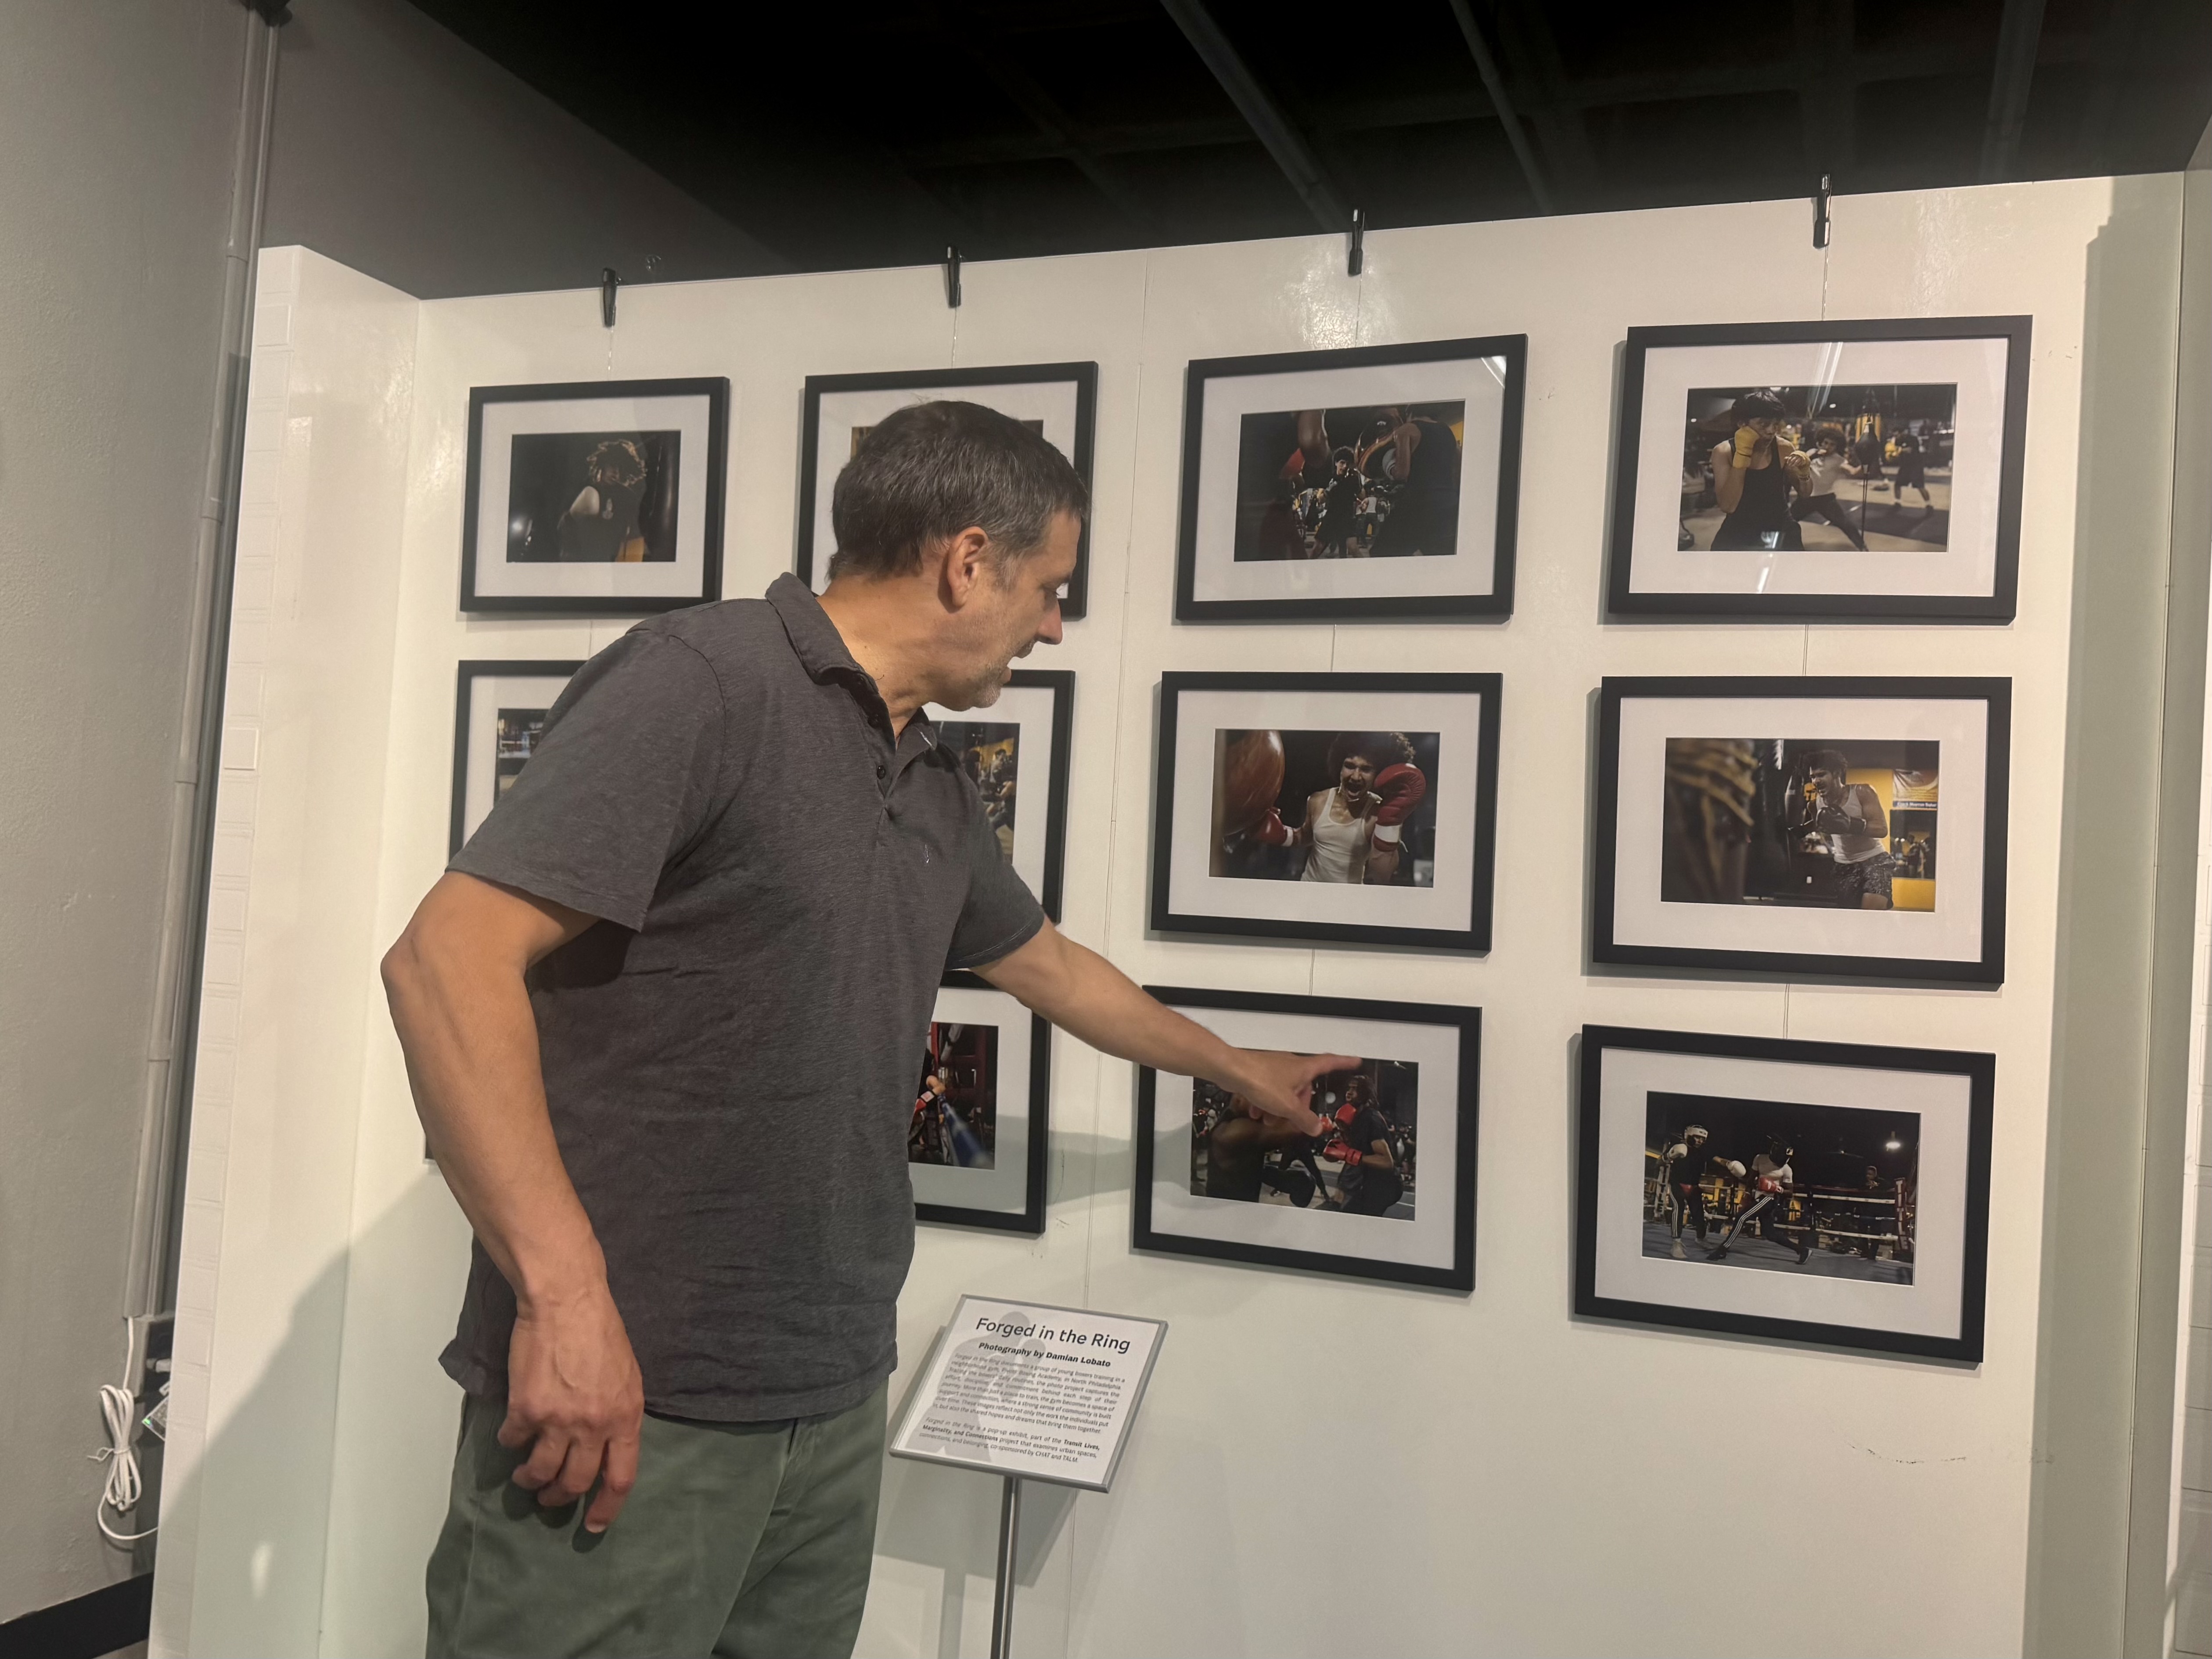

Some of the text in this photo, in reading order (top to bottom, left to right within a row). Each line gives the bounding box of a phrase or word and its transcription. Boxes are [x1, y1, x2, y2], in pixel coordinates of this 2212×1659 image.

[976, 1317, 1130, 1354] Forged in the Ring
[978, 1342, 1111, 1367] Photography by Damian Lobato
[989, 1357, 1000, 1365] Ring
[1093, 1374, 1114, 1382] training
[1018, 1370, 1036, 1378] Boxing
[1062, 1399, 1086, 1407] becomes
[1062, 1408, 1092, 1417] community
[1069, 1417, 1098, 1425] individuals
[923, 1425, 953, 1434] Marginality,
[965, 1431, 998, 1441] Connections
